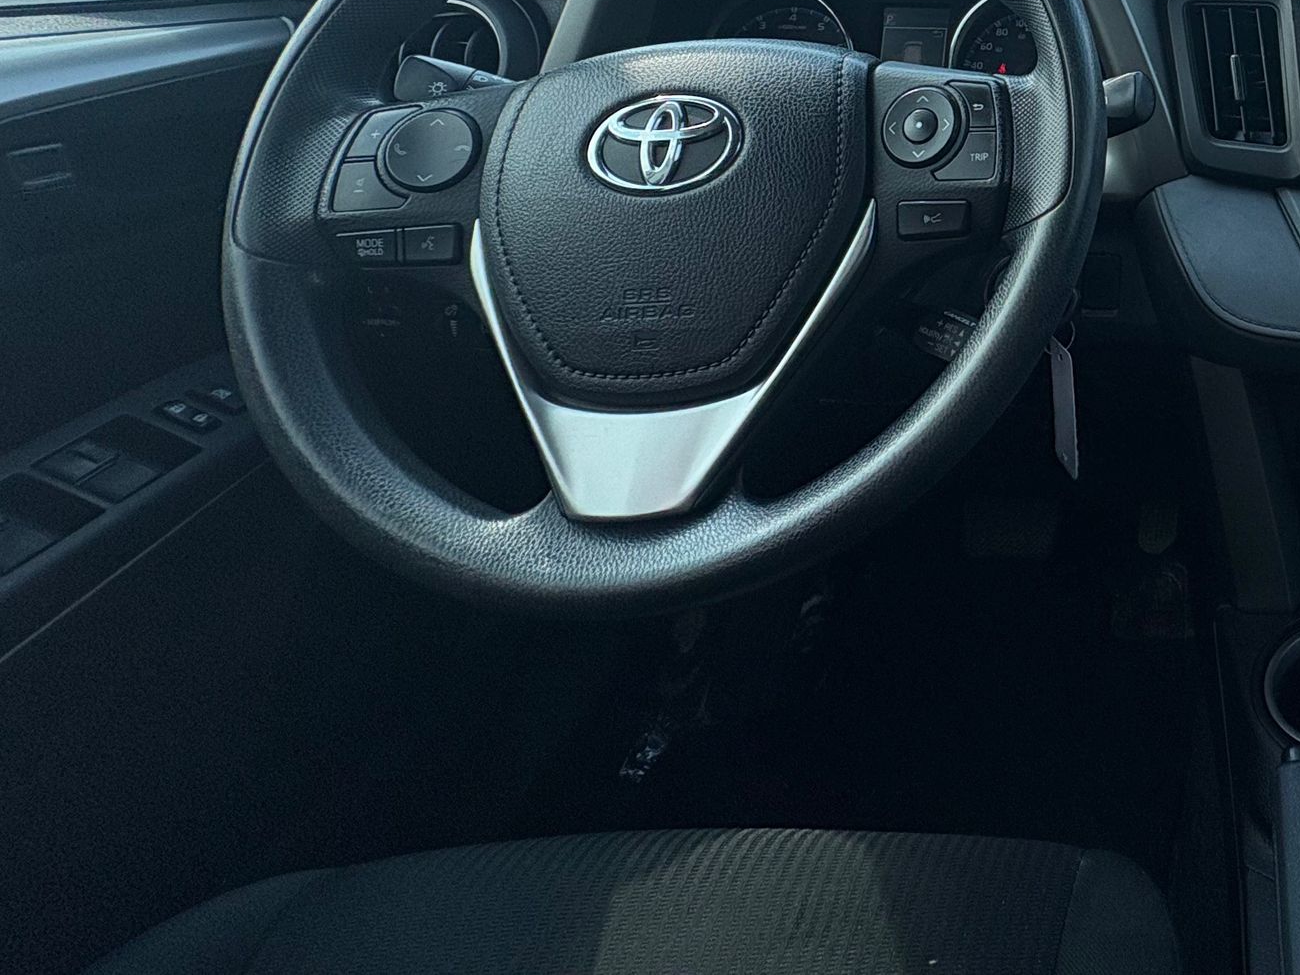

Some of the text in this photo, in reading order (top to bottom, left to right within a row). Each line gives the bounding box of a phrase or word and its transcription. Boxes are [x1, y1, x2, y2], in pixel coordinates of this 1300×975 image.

[995, 27, 1009, 36] 80
[980, 42, 993, 51] 60
[970, 153, 989, 161] TRIP
[356, 238, 384, 248] MODE
